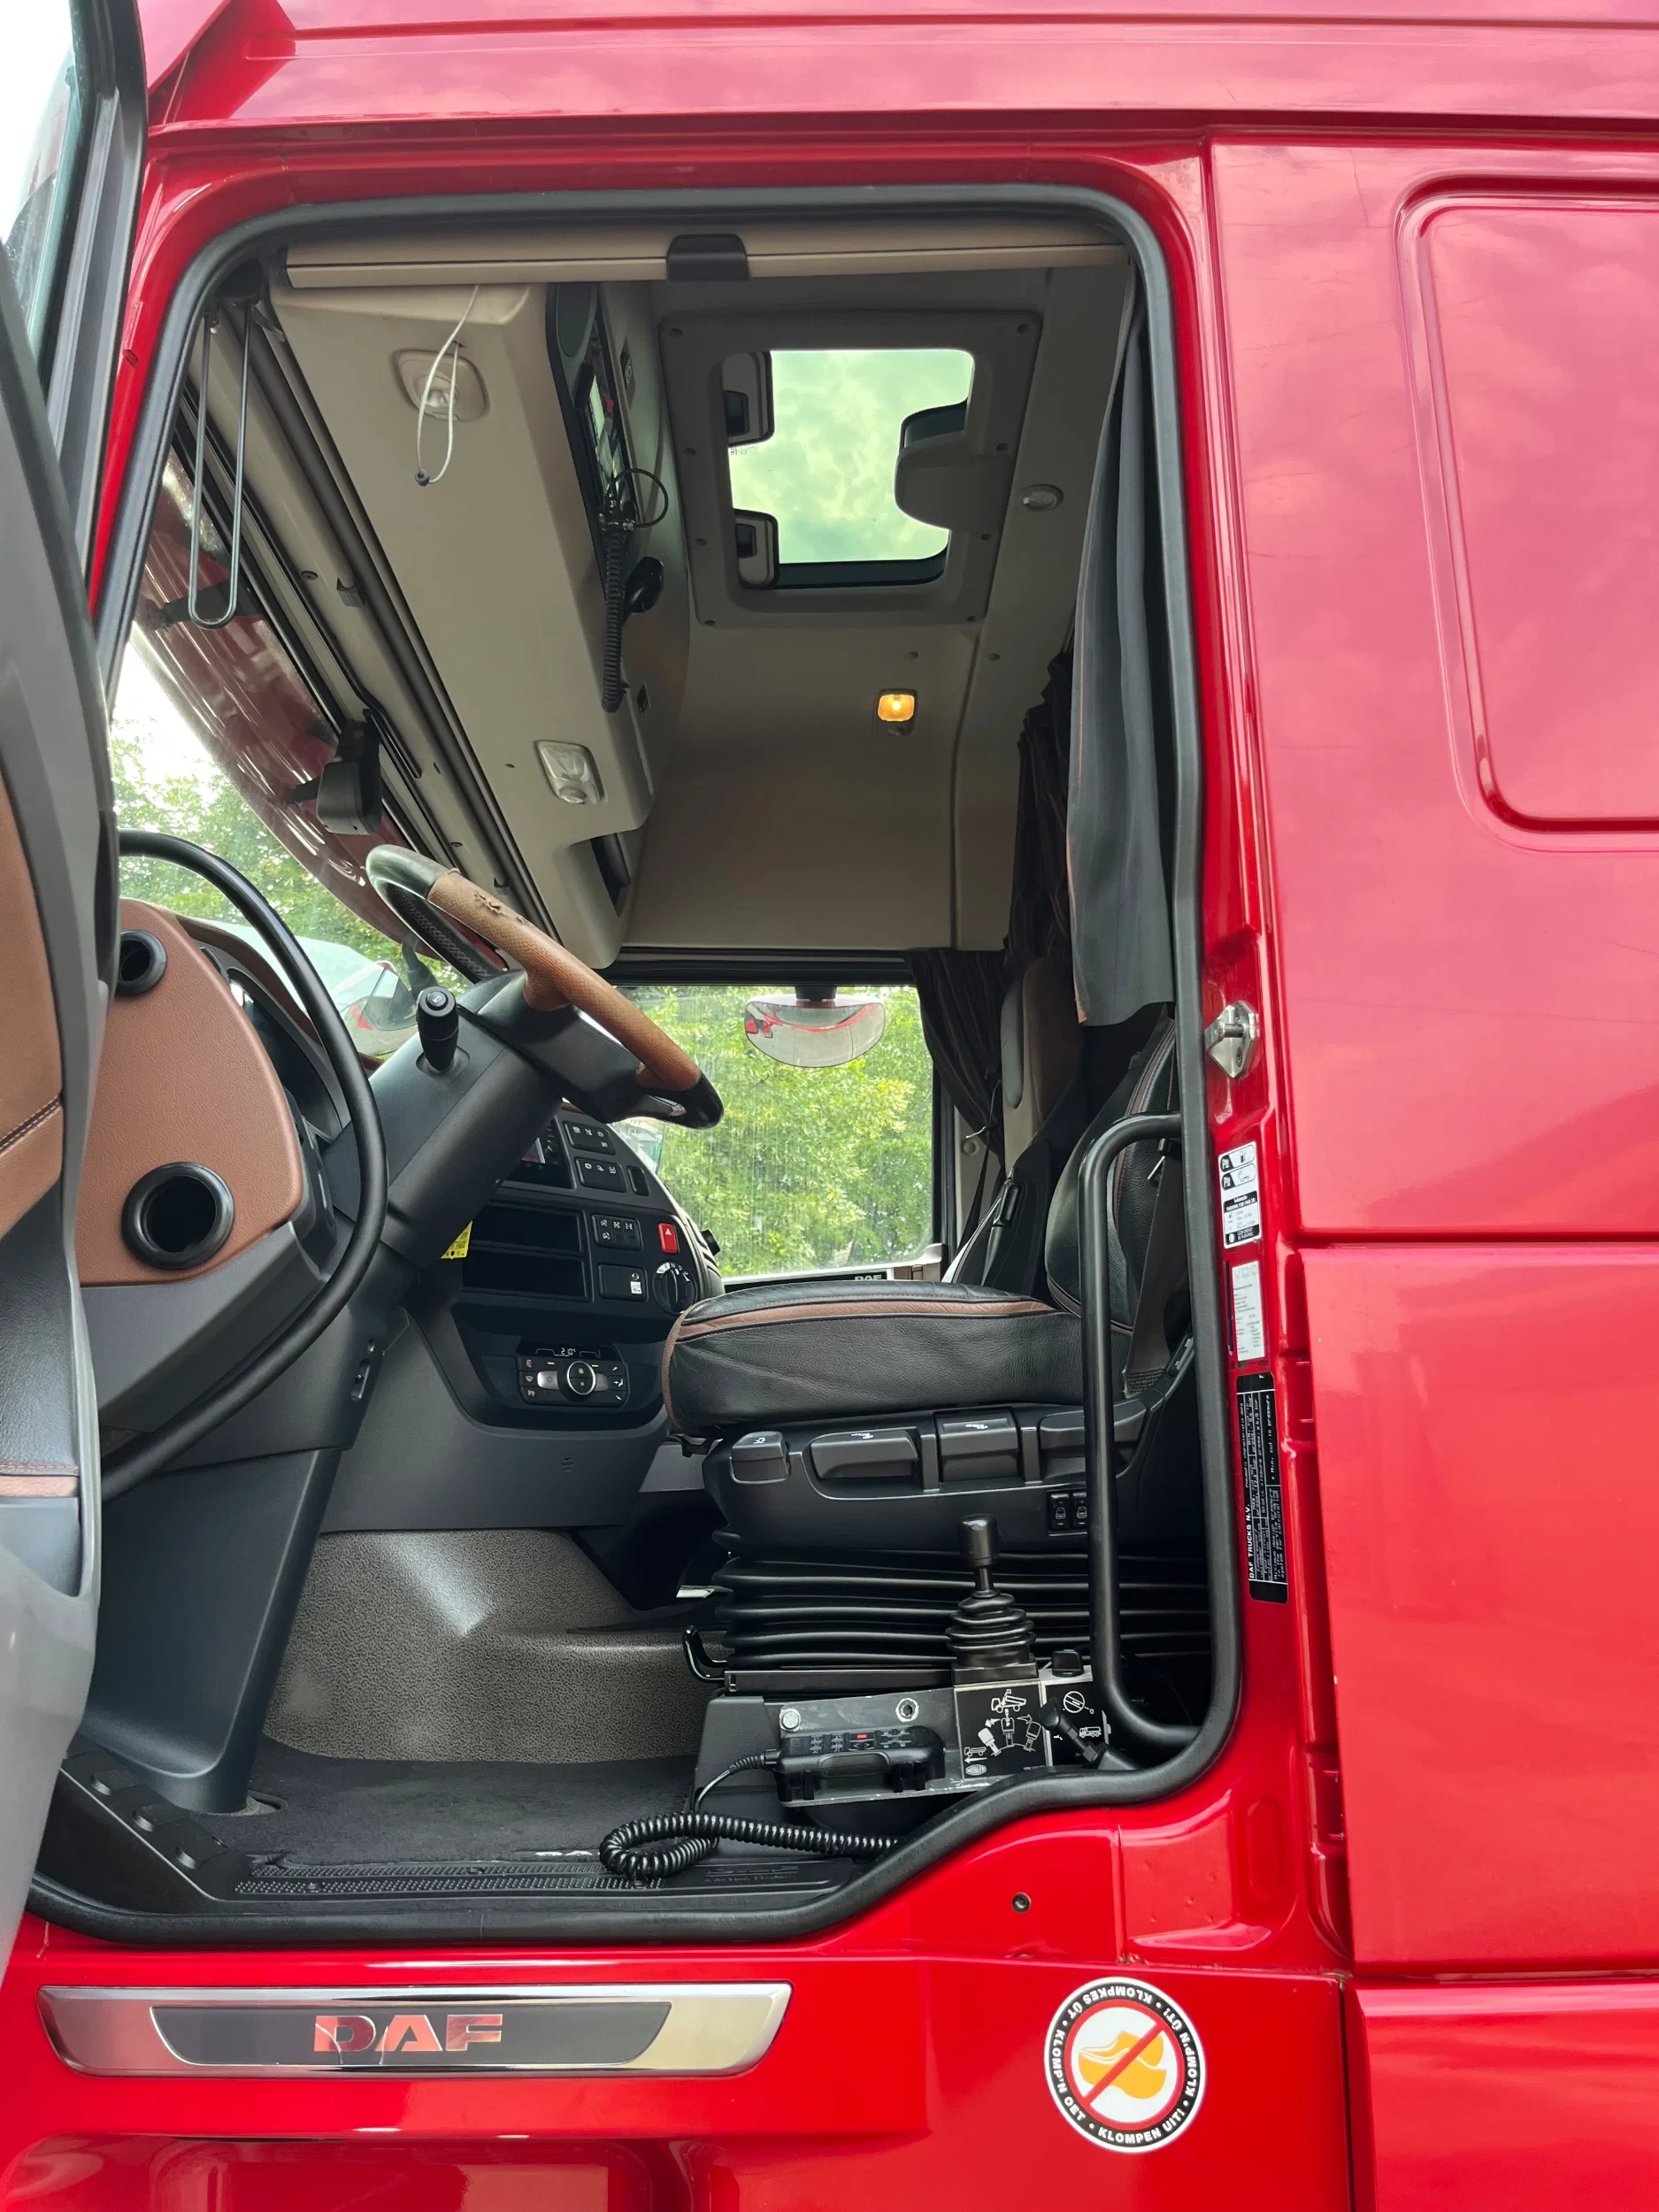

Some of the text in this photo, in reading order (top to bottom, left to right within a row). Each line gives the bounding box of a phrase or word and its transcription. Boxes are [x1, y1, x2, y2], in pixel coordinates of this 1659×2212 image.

[1082, 1985, 1153, 2005] KLOMPKES
[314, 2014, 503, 2052] DAF
[1064, 2096, 1086, 2121] OET
[1097, 2108, 1185, 2144] KLOMPEN UIT!
